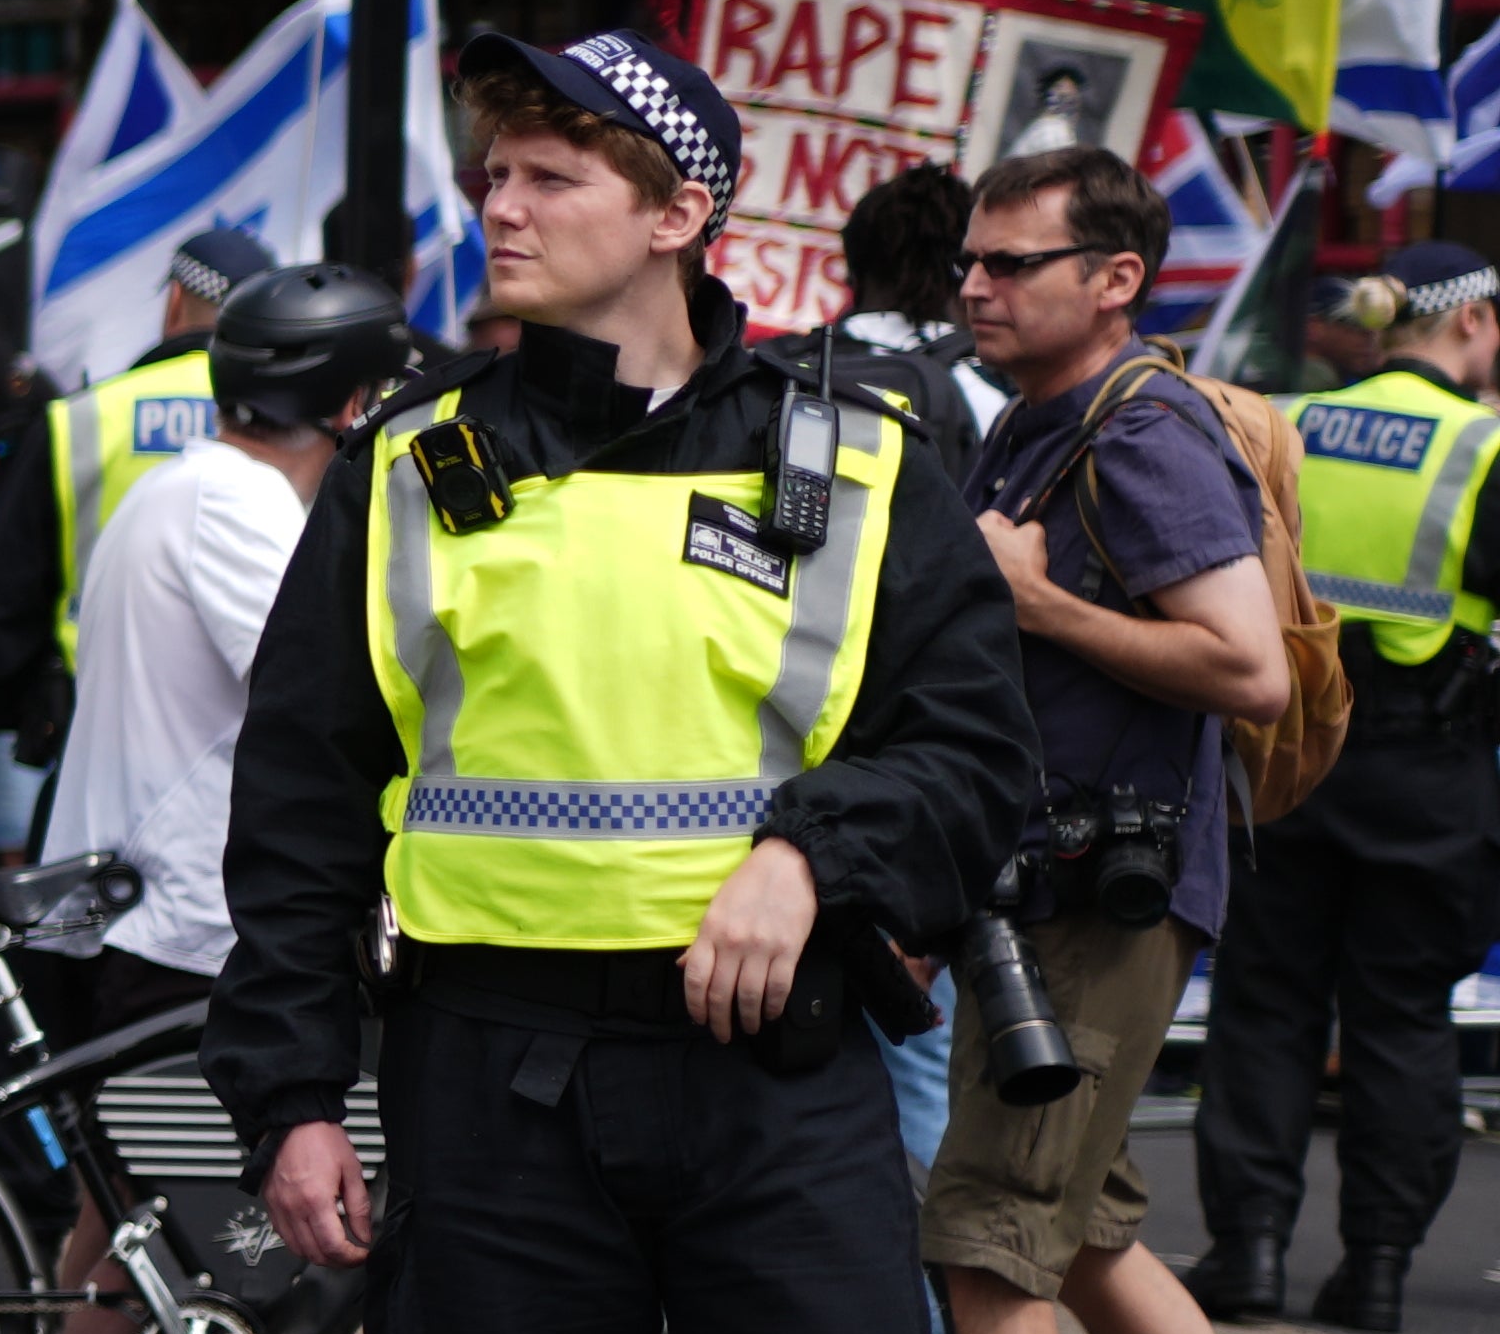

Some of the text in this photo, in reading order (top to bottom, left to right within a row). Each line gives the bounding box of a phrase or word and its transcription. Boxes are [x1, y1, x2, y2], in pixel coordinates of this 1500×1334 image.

[139, 400, 207, 446] POL
[1303, 405, 1432, 464] POLICE
[690, 547, 784, 590] POLICE OFFICER
[733, 547, 772, 571] POLICE
